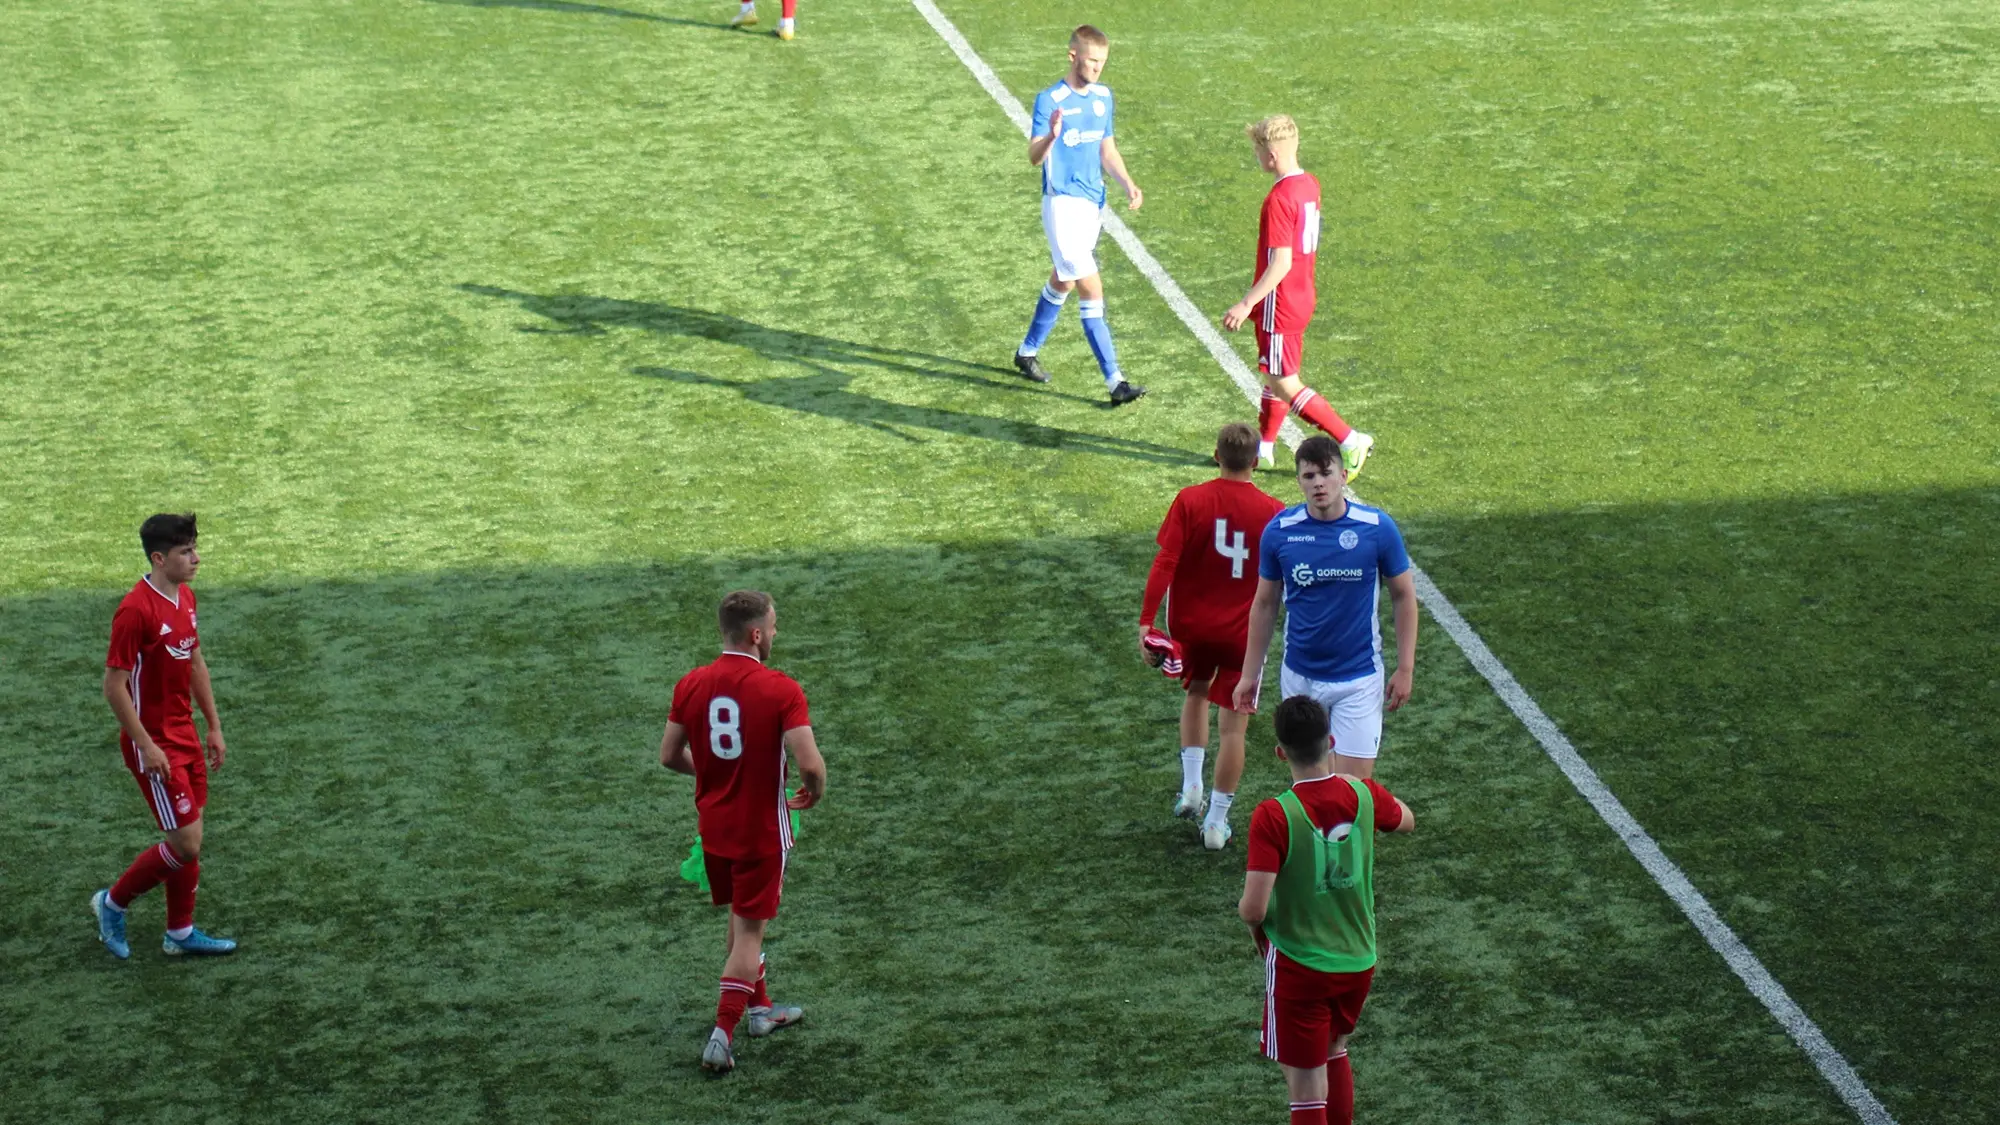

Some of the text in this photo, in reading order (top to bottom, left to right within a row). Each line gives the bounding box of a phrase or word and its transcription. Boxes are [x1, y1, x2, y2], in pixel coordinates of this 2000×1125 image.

[1214, 518, 1250, 579] 4
[1287, 535, 1316, 543] macron
[1316, 568, 1363, 577] GORDONS
[709, 696, 742, 760] 8
